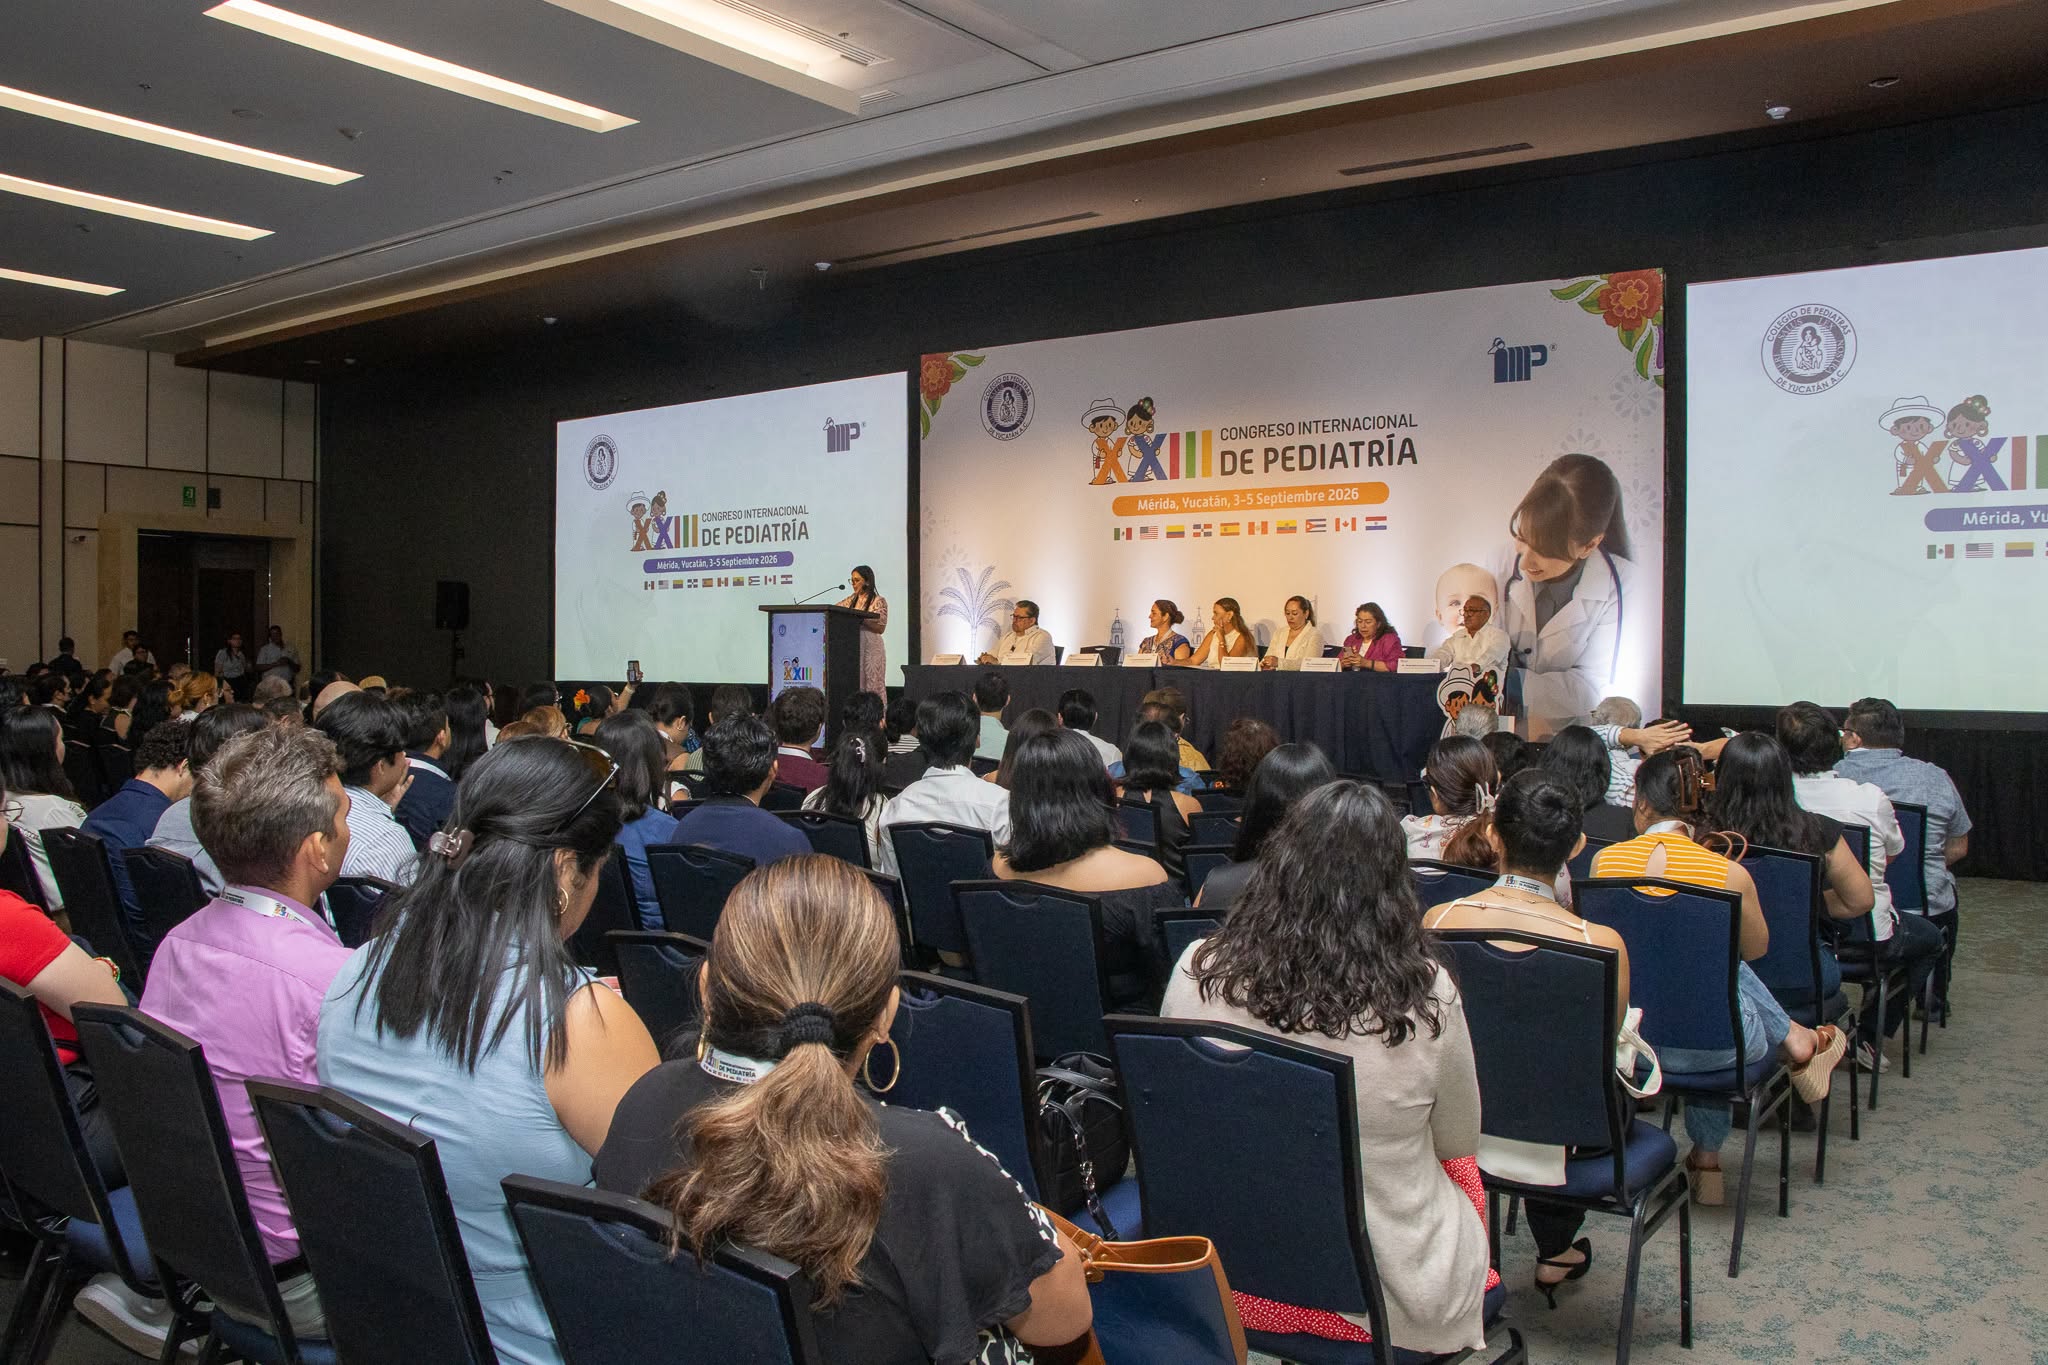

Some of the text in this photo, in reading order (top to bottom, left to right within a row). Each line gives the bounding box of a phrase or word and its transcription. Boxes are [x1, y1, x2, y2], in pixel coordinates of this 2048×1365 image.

[1767, 307, 1852, 342] COLEGIO DE PEDIATRAS
[984, 378, 1002, 402] COLEGIO
[1010, 375, 1032, 397] PEDIATRAS
[1776, 377, 1787, 388] DE
[1788, 381, 1829, 393] YUCATÁN
[1220, 413, 1418, 441] CONGRESO INTERNACIONAL
[1094, 430, 1213, 485] XXIII
[1220, 433, 1418, 476] DE PEDIATRÍA
[1137, 495, 1179, 511] Mérida,
[1182, 494, 1231, 508] Yucatán,
[1256, 489, 1325, 507] Septiembre
[1328, 487, 1359, 501] 2026
[701, 505, 809, 523] CONGRESO INTERNACIONAL
[1962, 511, 2025, 526] Mérida,
[631, 514, 699, 551] XXIII
[702, 518, 809, 547] DE PEDIATRÍA
[656, 558, 680, 570] Mérida,
[681, 557, 708, 569] Yucatán,
[721, 555, 759, 569] Septiembre
[760, 554, 778, 564] 2026
[783, 666, 812, 681] XXIII
[726, 1066, 756, 1078] PEDIATRÍA
